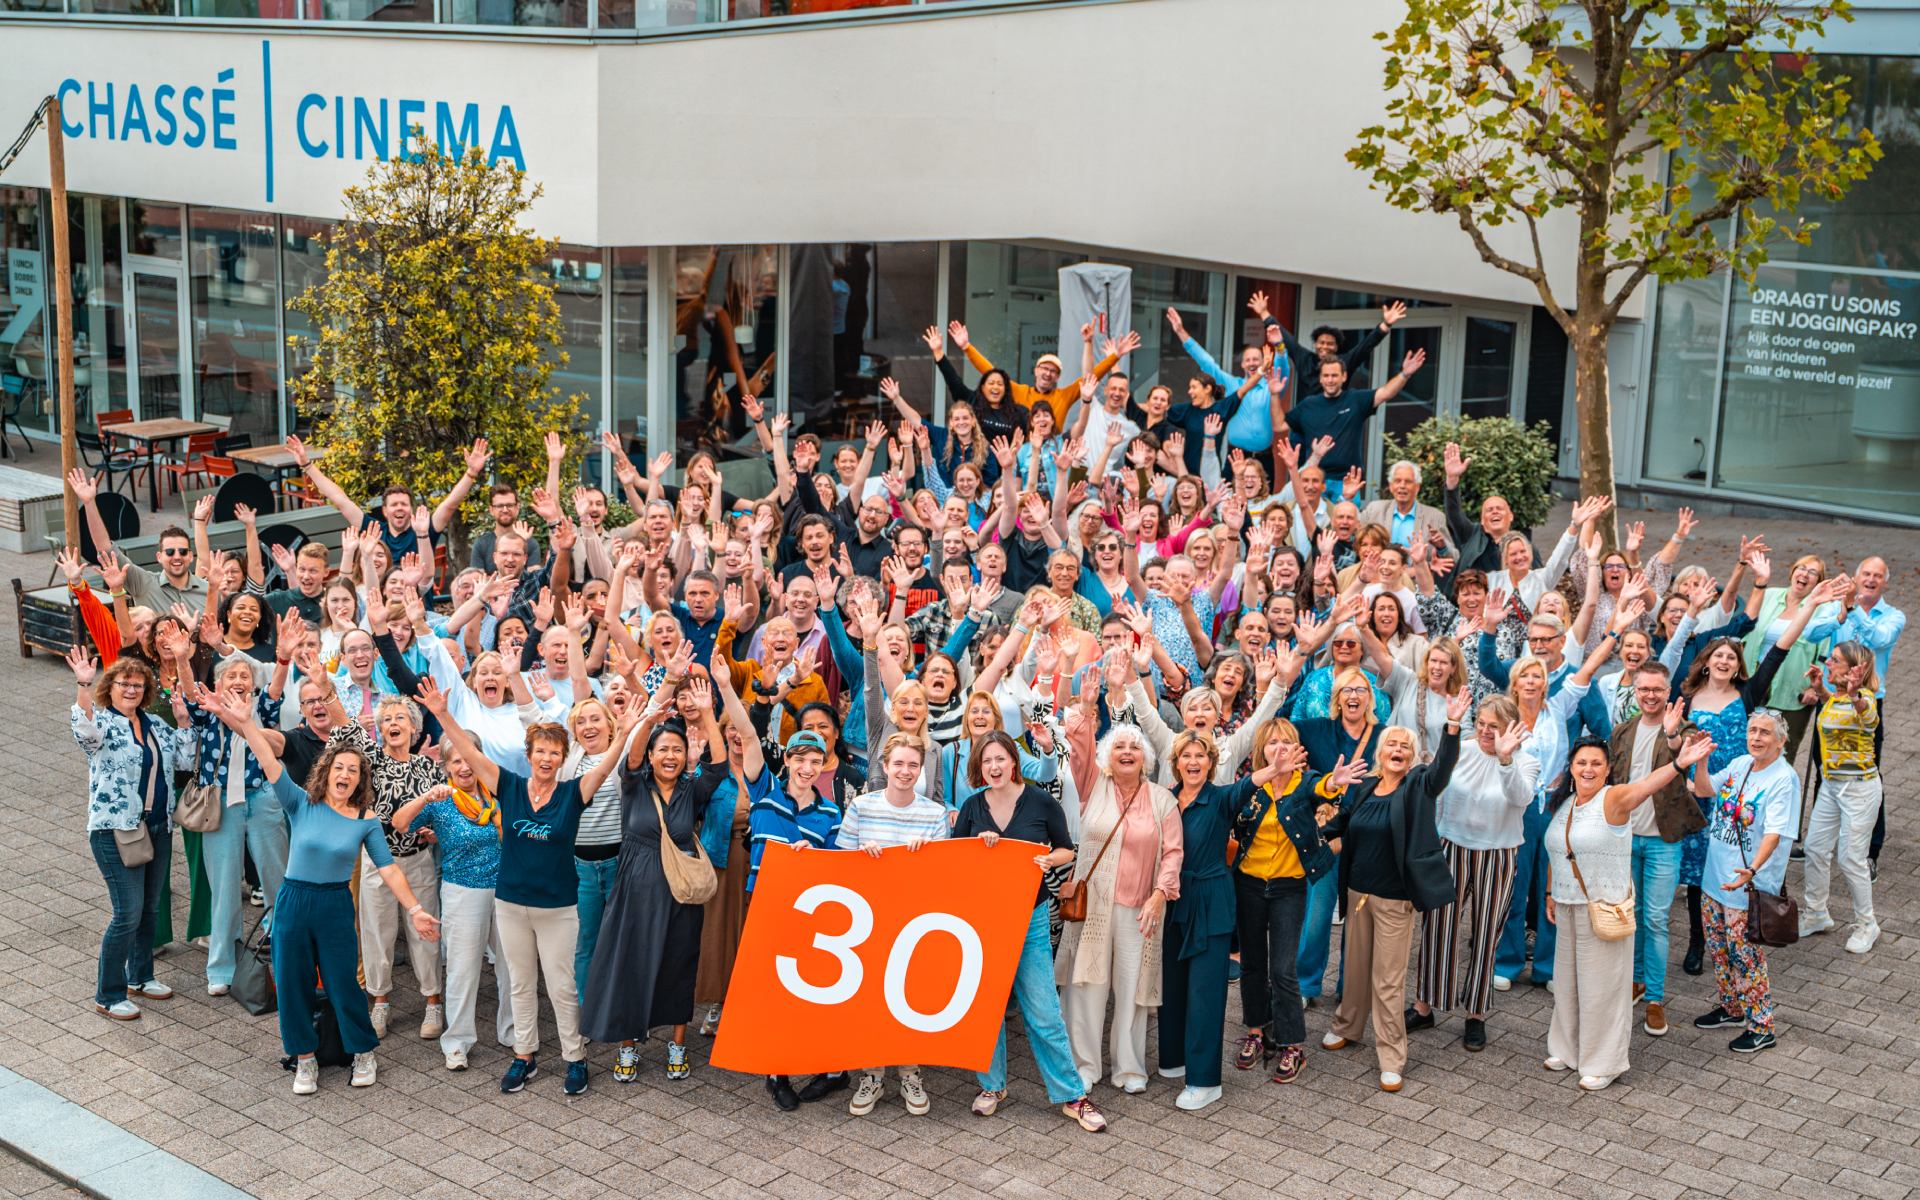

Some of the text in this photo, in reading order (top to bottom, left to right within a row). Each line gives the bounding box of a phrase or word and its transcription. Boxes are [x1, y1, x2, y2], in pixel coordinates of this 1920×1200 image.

[58, 68, 527, 171] CHASSÉ CINEMA
[1751, 289, 1901, 317] DRAAGT U SOMS
[1750, 308, 1918, 340] EEN JOGGINGPAK?
[1031, 336, 1059, 345] LUNC
[1748, 331, 1855, 354] kijk door de ogen
[1746, 349, 1826, 366] van kinderen
[1744, 365, 1893, 390] naar de wereld en jezelf
[775, 884, 984, 1033] 30
